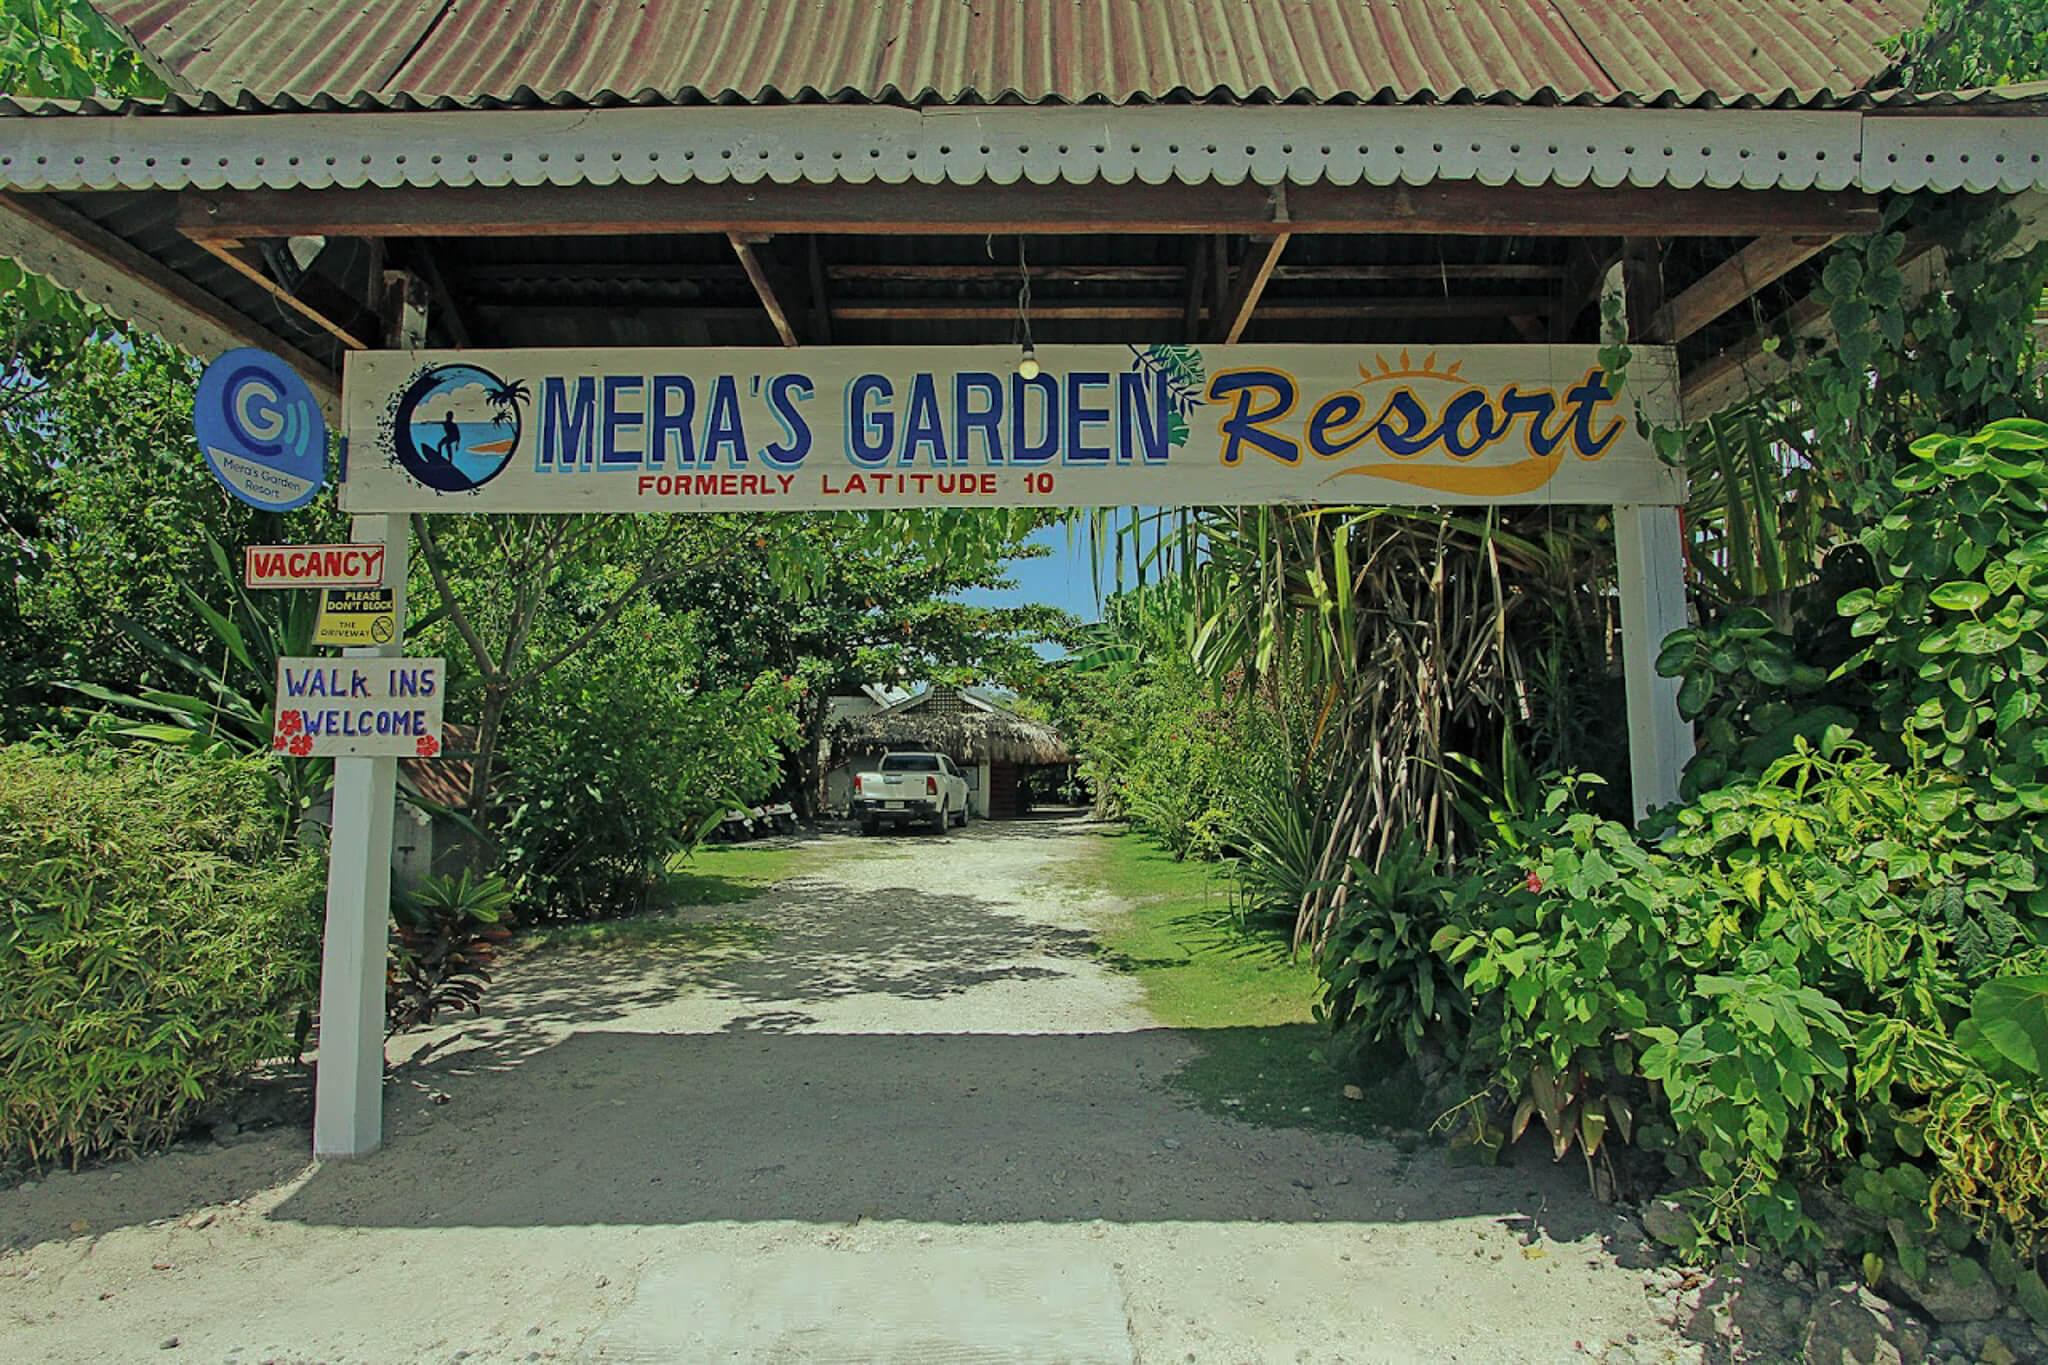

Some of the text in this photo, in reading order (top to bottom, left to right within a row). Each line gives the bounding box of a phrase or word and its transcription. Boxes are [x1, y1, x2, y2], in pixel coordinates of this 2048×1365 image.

[535, 366, 1627, 472] MERA'S GARDEN Resort
[223, 456, 300, 491] Mera's Garden
[637, 472, 1055, 496] FORMERLY LATITUDE 10
[245, 479, 281, 498] Resort
[254, 550, 383, 578] VACANCY
[327, 601, 393, 611] DON'T BLOCK
[345, 591, 381, 601] PLEASE
[320, 628, 370, 638] DRIVEWAY
[339, 621, 356, 629] THE
[388, 667, 437, 697] INS
[301, 708, 428, 738] WELCOME
